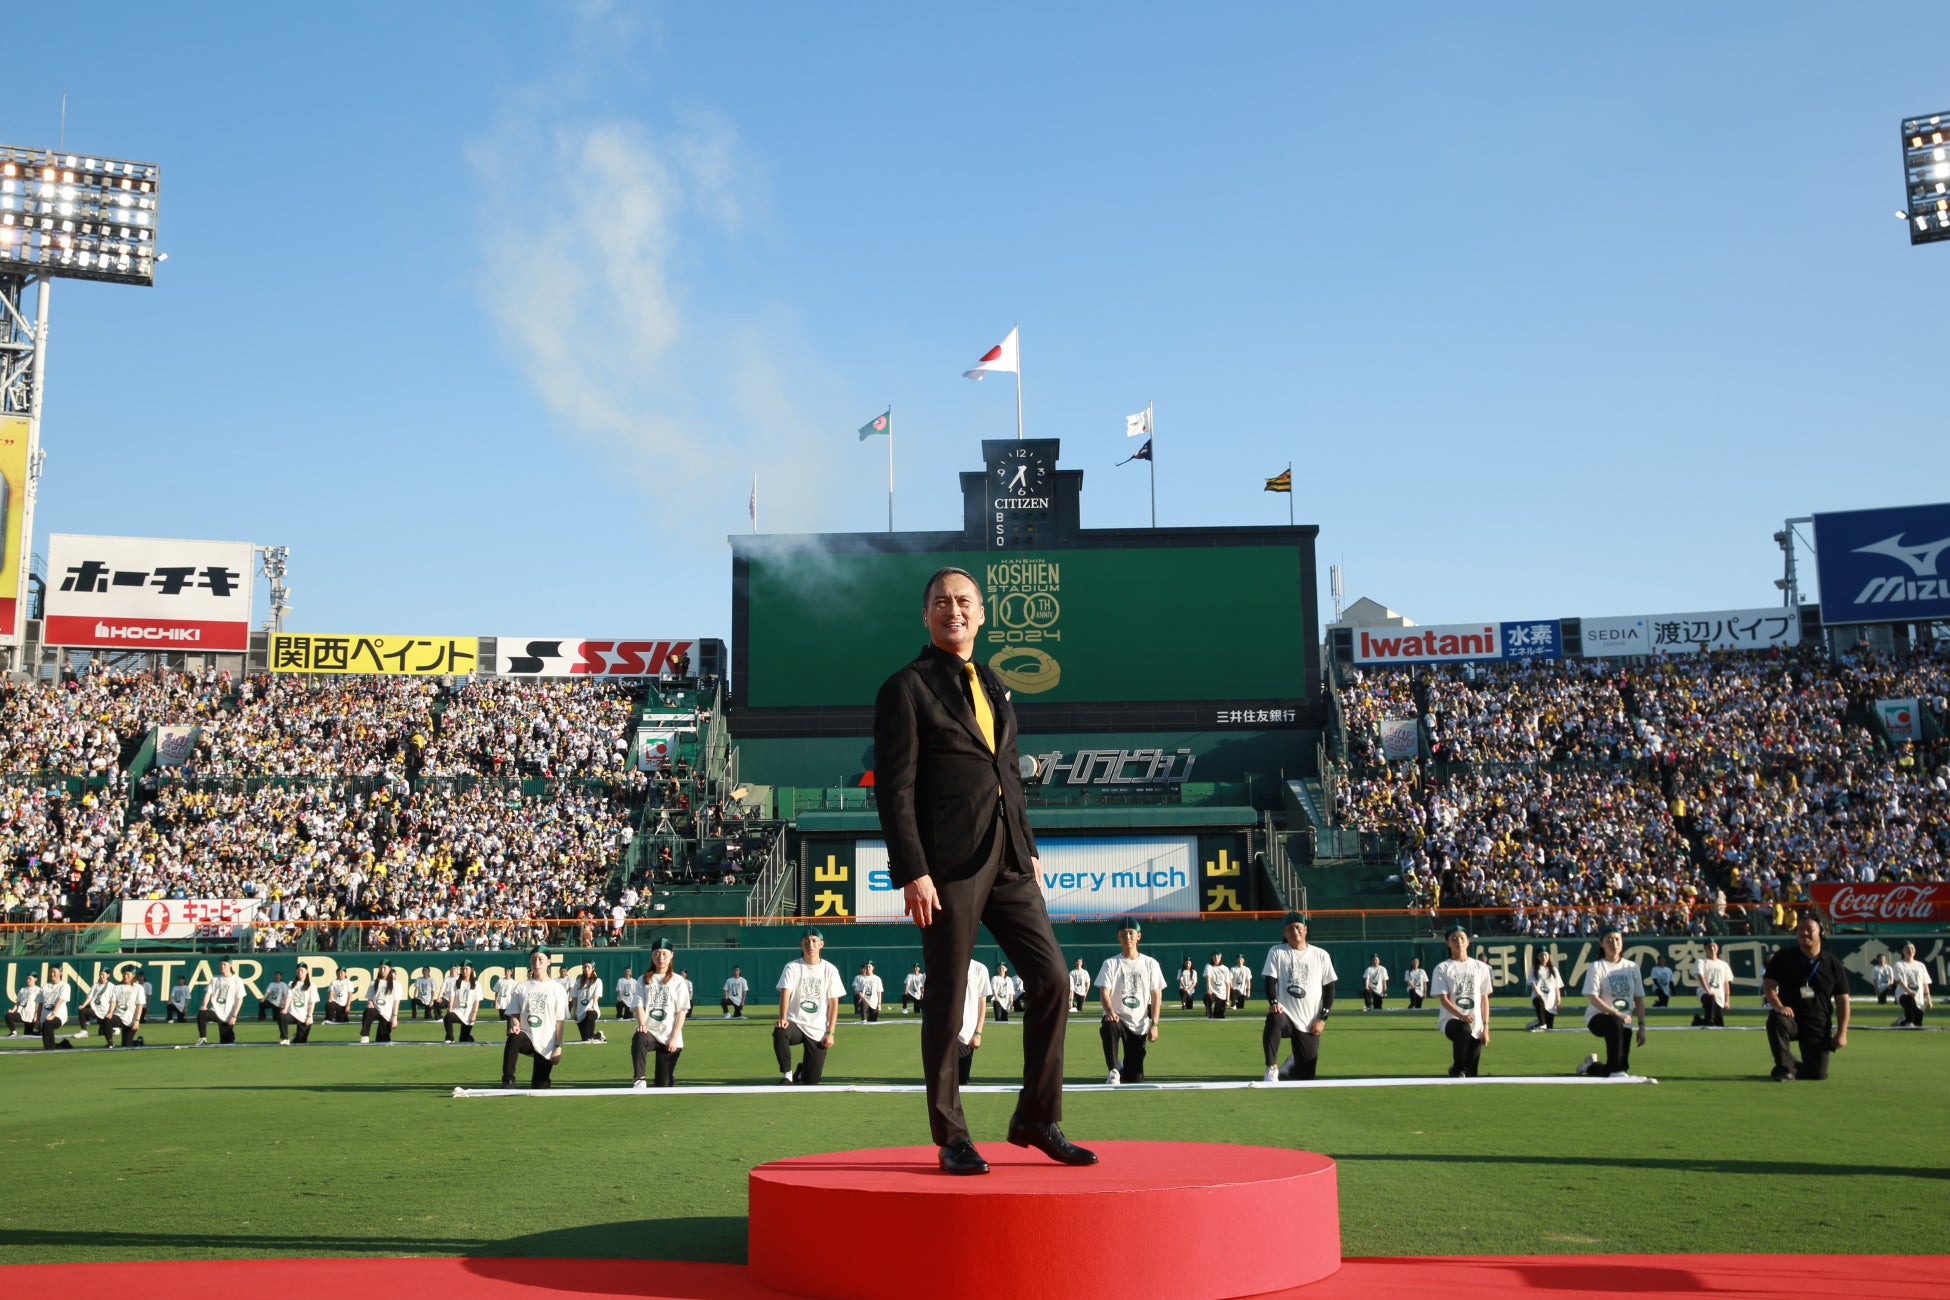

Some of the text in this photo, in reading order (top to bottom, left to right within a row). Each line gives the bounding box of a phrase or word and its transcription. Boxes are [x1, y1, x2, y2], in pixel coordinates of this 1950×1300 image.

[1016, 449, 1027, 458] 12
[997, 468, 1005, 477] 9
[1037, 467, 1046, 476] 3
[1017, 488, 1026, 496] 6
[994, 498, 1049, 509] CITIZEN
[60, 560, 240, 597] ホーチキ
[987, 564, 1060, 585] KOSHIEN
[987, 592, 1060, 629] 100
[1038, 599, 1051, 611] TH
[110, 625, 200, 641] HOCHIKI
[987, 630, 1061, 643] 2024
[1508, 624, 1553, 646] 水素
[1588, 628, 1639, 641] SEDIA
[1654, 613, 1796, 645] 渡辺パイプ
[1360, 627, 1494, 658] Iwatani
[1509, 647, 1554, 656] エネルギー
[274, 636, 474, 672] 関西ペイント
[570, 641, 693, 675] SSK
[1216, 709, 1296, 723] 三井住友銀行
[814, 855, 849, 917] 山九
[1044, 866, 1187, 892] very much
[1206, 849, 1242, 911] 山九
[183, 899, 242, 924] キューピー
[1829, 885, 1938, 919] Coca-Cola
